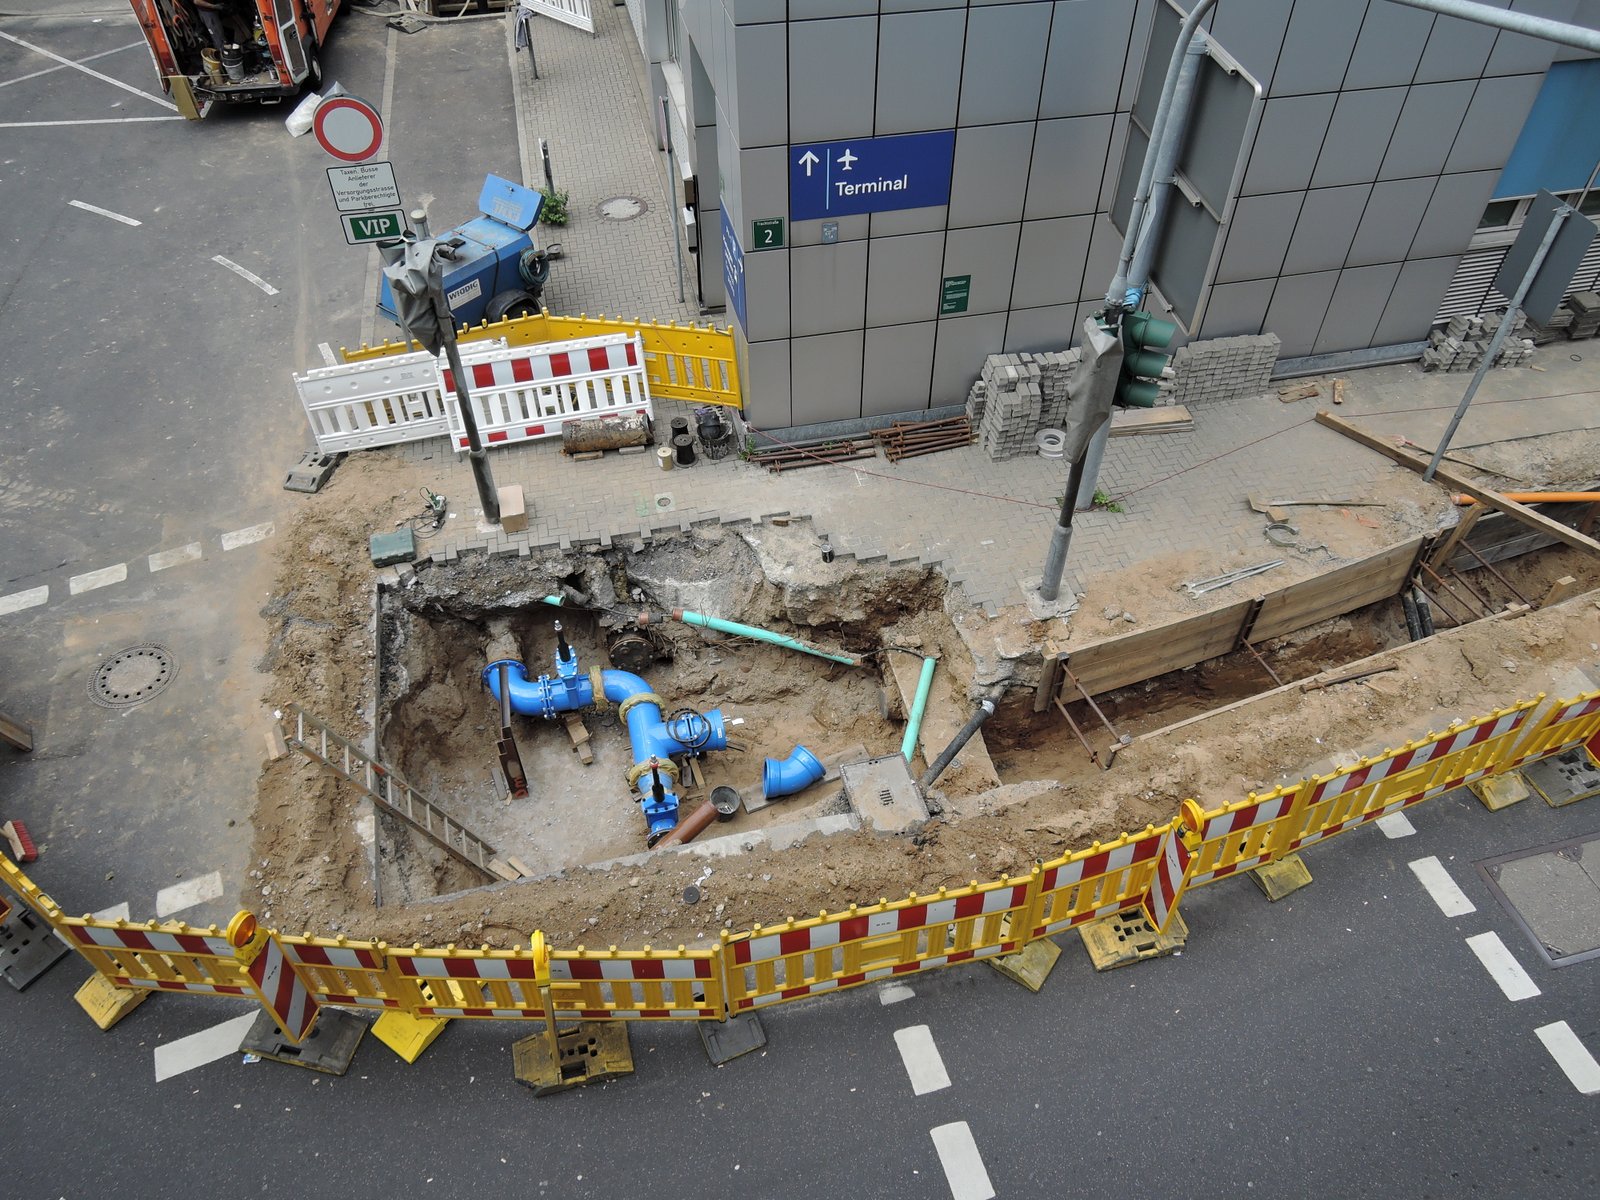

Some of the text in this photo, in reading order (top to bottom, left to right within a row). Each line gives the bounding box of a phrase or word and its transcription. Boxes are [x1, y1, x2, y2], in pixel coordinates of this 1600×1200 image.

[835, 174, 907, 196] Terminal
[358, 218, 390, 236] VIP
[764, 229, 773, 243] 2
